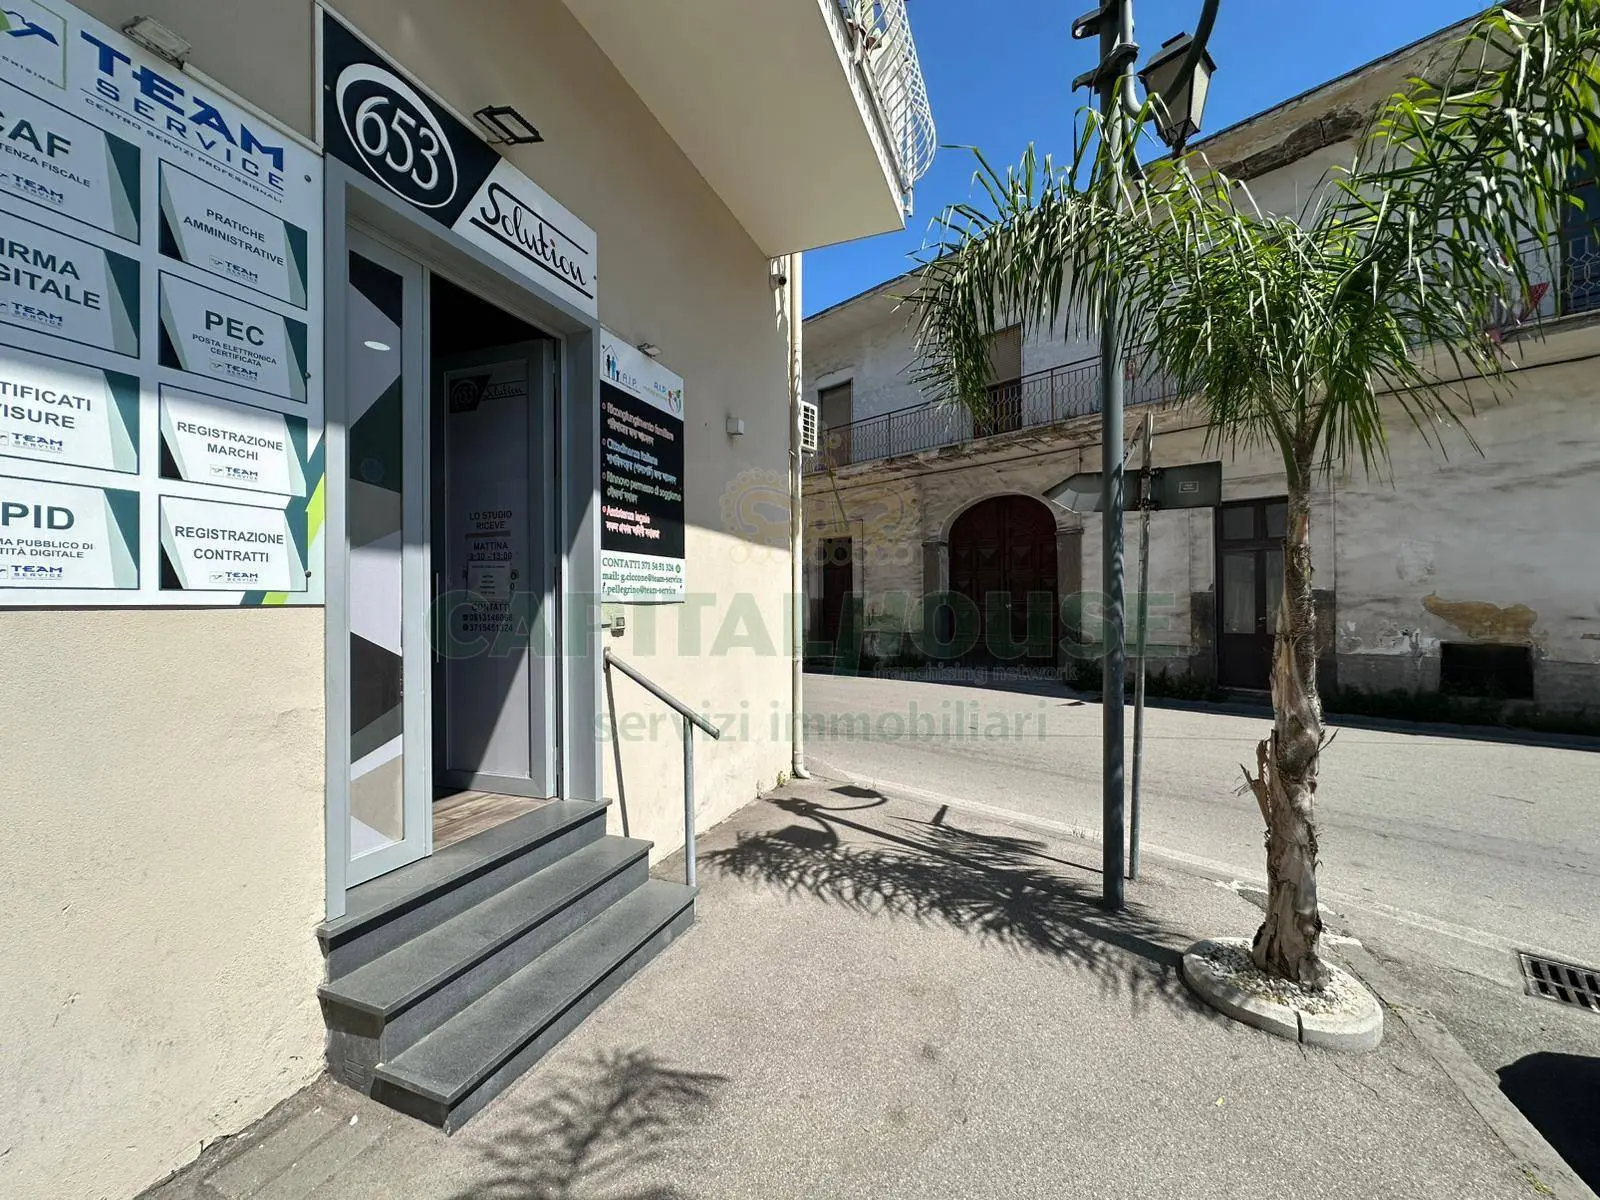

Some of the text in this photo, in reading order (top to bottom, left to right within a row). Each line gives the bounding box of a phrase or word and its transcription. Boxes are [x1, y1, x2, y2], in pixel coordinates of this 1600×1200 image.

[80, 29, 284, 173] TEAM
[0, 110, 72, 158] AF
[85, 98, 142, 131] CENTRO
[146, 129, 194, 158] SERVIZI
[96, 77, 284, 191] SERVICE
[355, 95, 441, 190] 653
[12, 173, 64, 200] TEAM
[41, 160, 91, 188] FISCALE
[206, 208, 265, 242] PRATICHE
[480, 182, 588, 286] Solution
[183, 215, 285, 266] AMMINISTRATIVE
[11, 301, 63, 322] TEAM
[205, 309, 265, 347] PEC
[192, 333, 277, 366] POSTA ELETTRONICA
[210, 346, 262, 367] CERTIFICATA
[0, 403, 76, 430] ISURE
[11, 432, 63, 447] TEAM
[177, 421, 283, 452] REGISTRAZIONE
[207, 443, 259, 461] MARCHI
[225, 466, 258, 477] TEAM
[1, 501, 75, 531] PID
[469, 510, 513, 521] LO STUDIO
[476, 520, 505, 530] RICEVE
[17, 538, 79, 550] PUBBLICO
[175, 525, 284, 545] REGISTRAZIONE
[473, 541, 509, 551] MATTINA
[30, 549, 84, 559] DIGITALE
[193, 548, 269, 562] CONTRATTI
[602, 557, 641, 569] CONTATTI
[11, 565, 63, 573] TEAM
